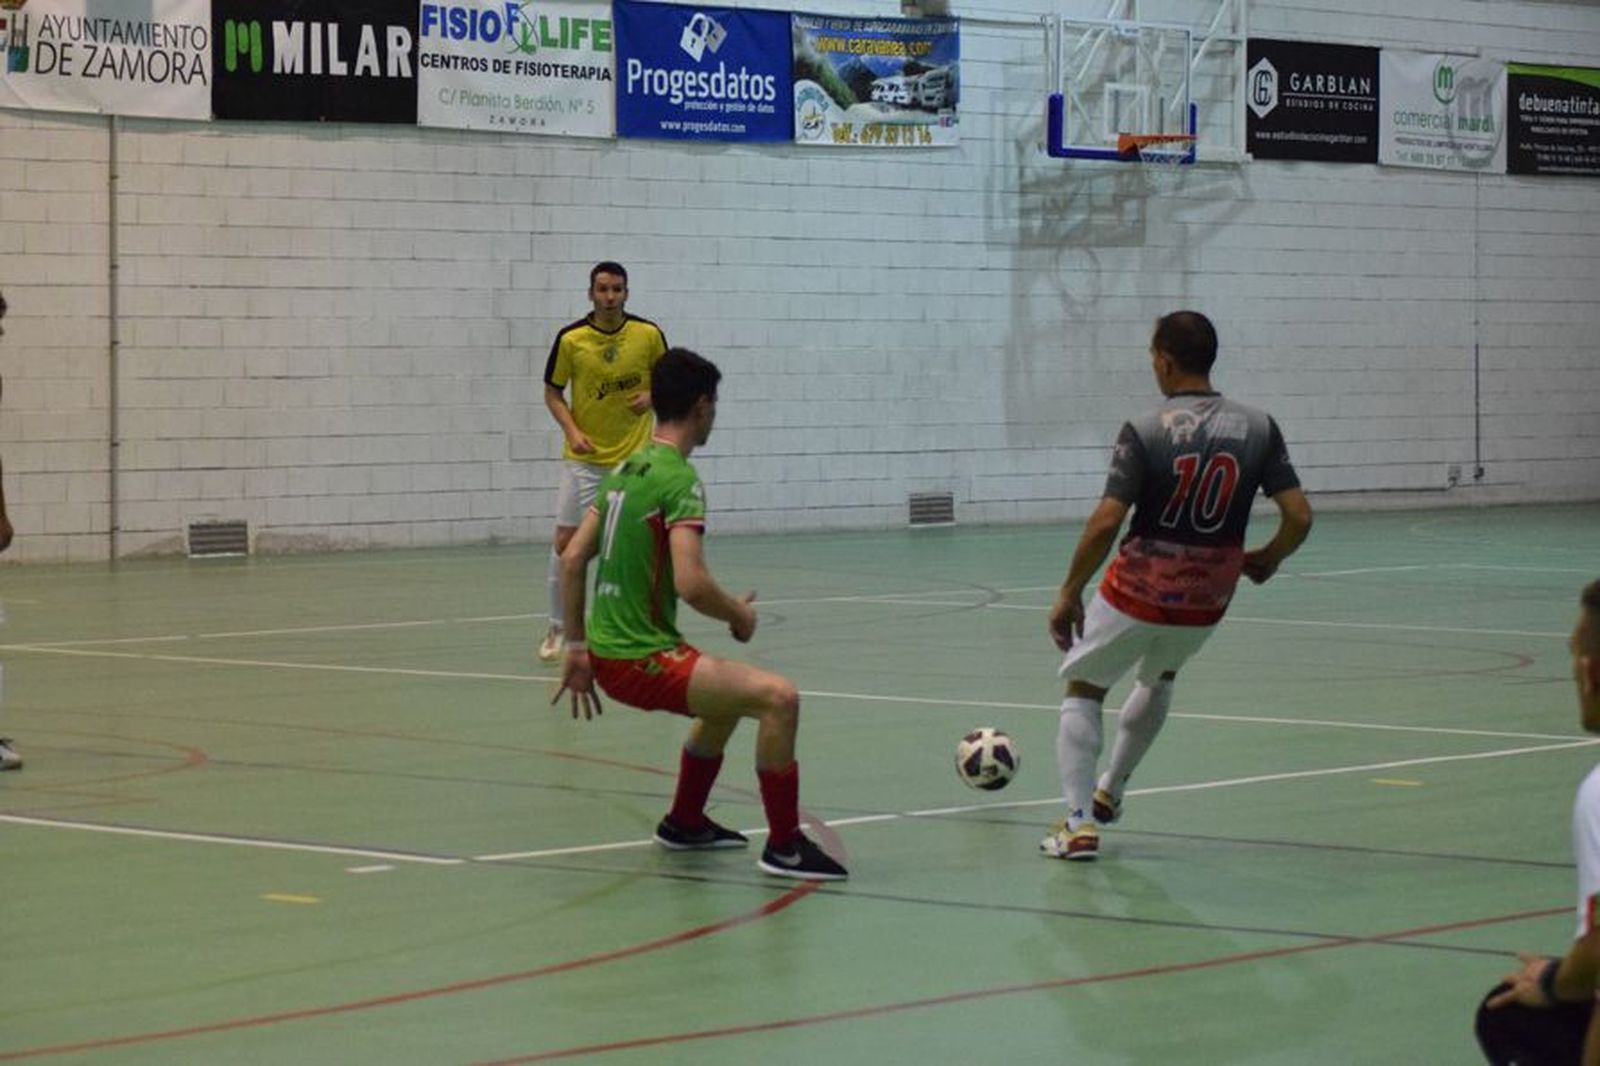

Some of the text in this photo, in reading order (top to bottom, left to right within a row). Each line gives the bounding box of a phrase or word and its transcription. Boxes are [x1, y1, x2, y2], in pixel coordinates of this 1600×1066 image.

[38, 14, 208, 51] AYUNTAMIENTO
[271, 20, 413, 78] MILAR
[34, 41, 207, 86] DE ZAMORA
[420, 52, 612, 82] CENTROS DE FISIOTERAPIA
[627, 58, 776, 105] Progesdatos
[1289, 72, 1371, 95] GARBLAN
[438, 88, 457, 106] C/
[459, 90, 511, 108] Pianista
[587, 102, 596, 115] 5
[1519, 92, 1600, 115] debuenatinta
[489, 114, 546, 127] ZAMORA
[660, 119, 746, 134] www.progesdatos.com
[1393, 111, 1453, 130] comercial
[1159, 452, 1240, 533] 10
